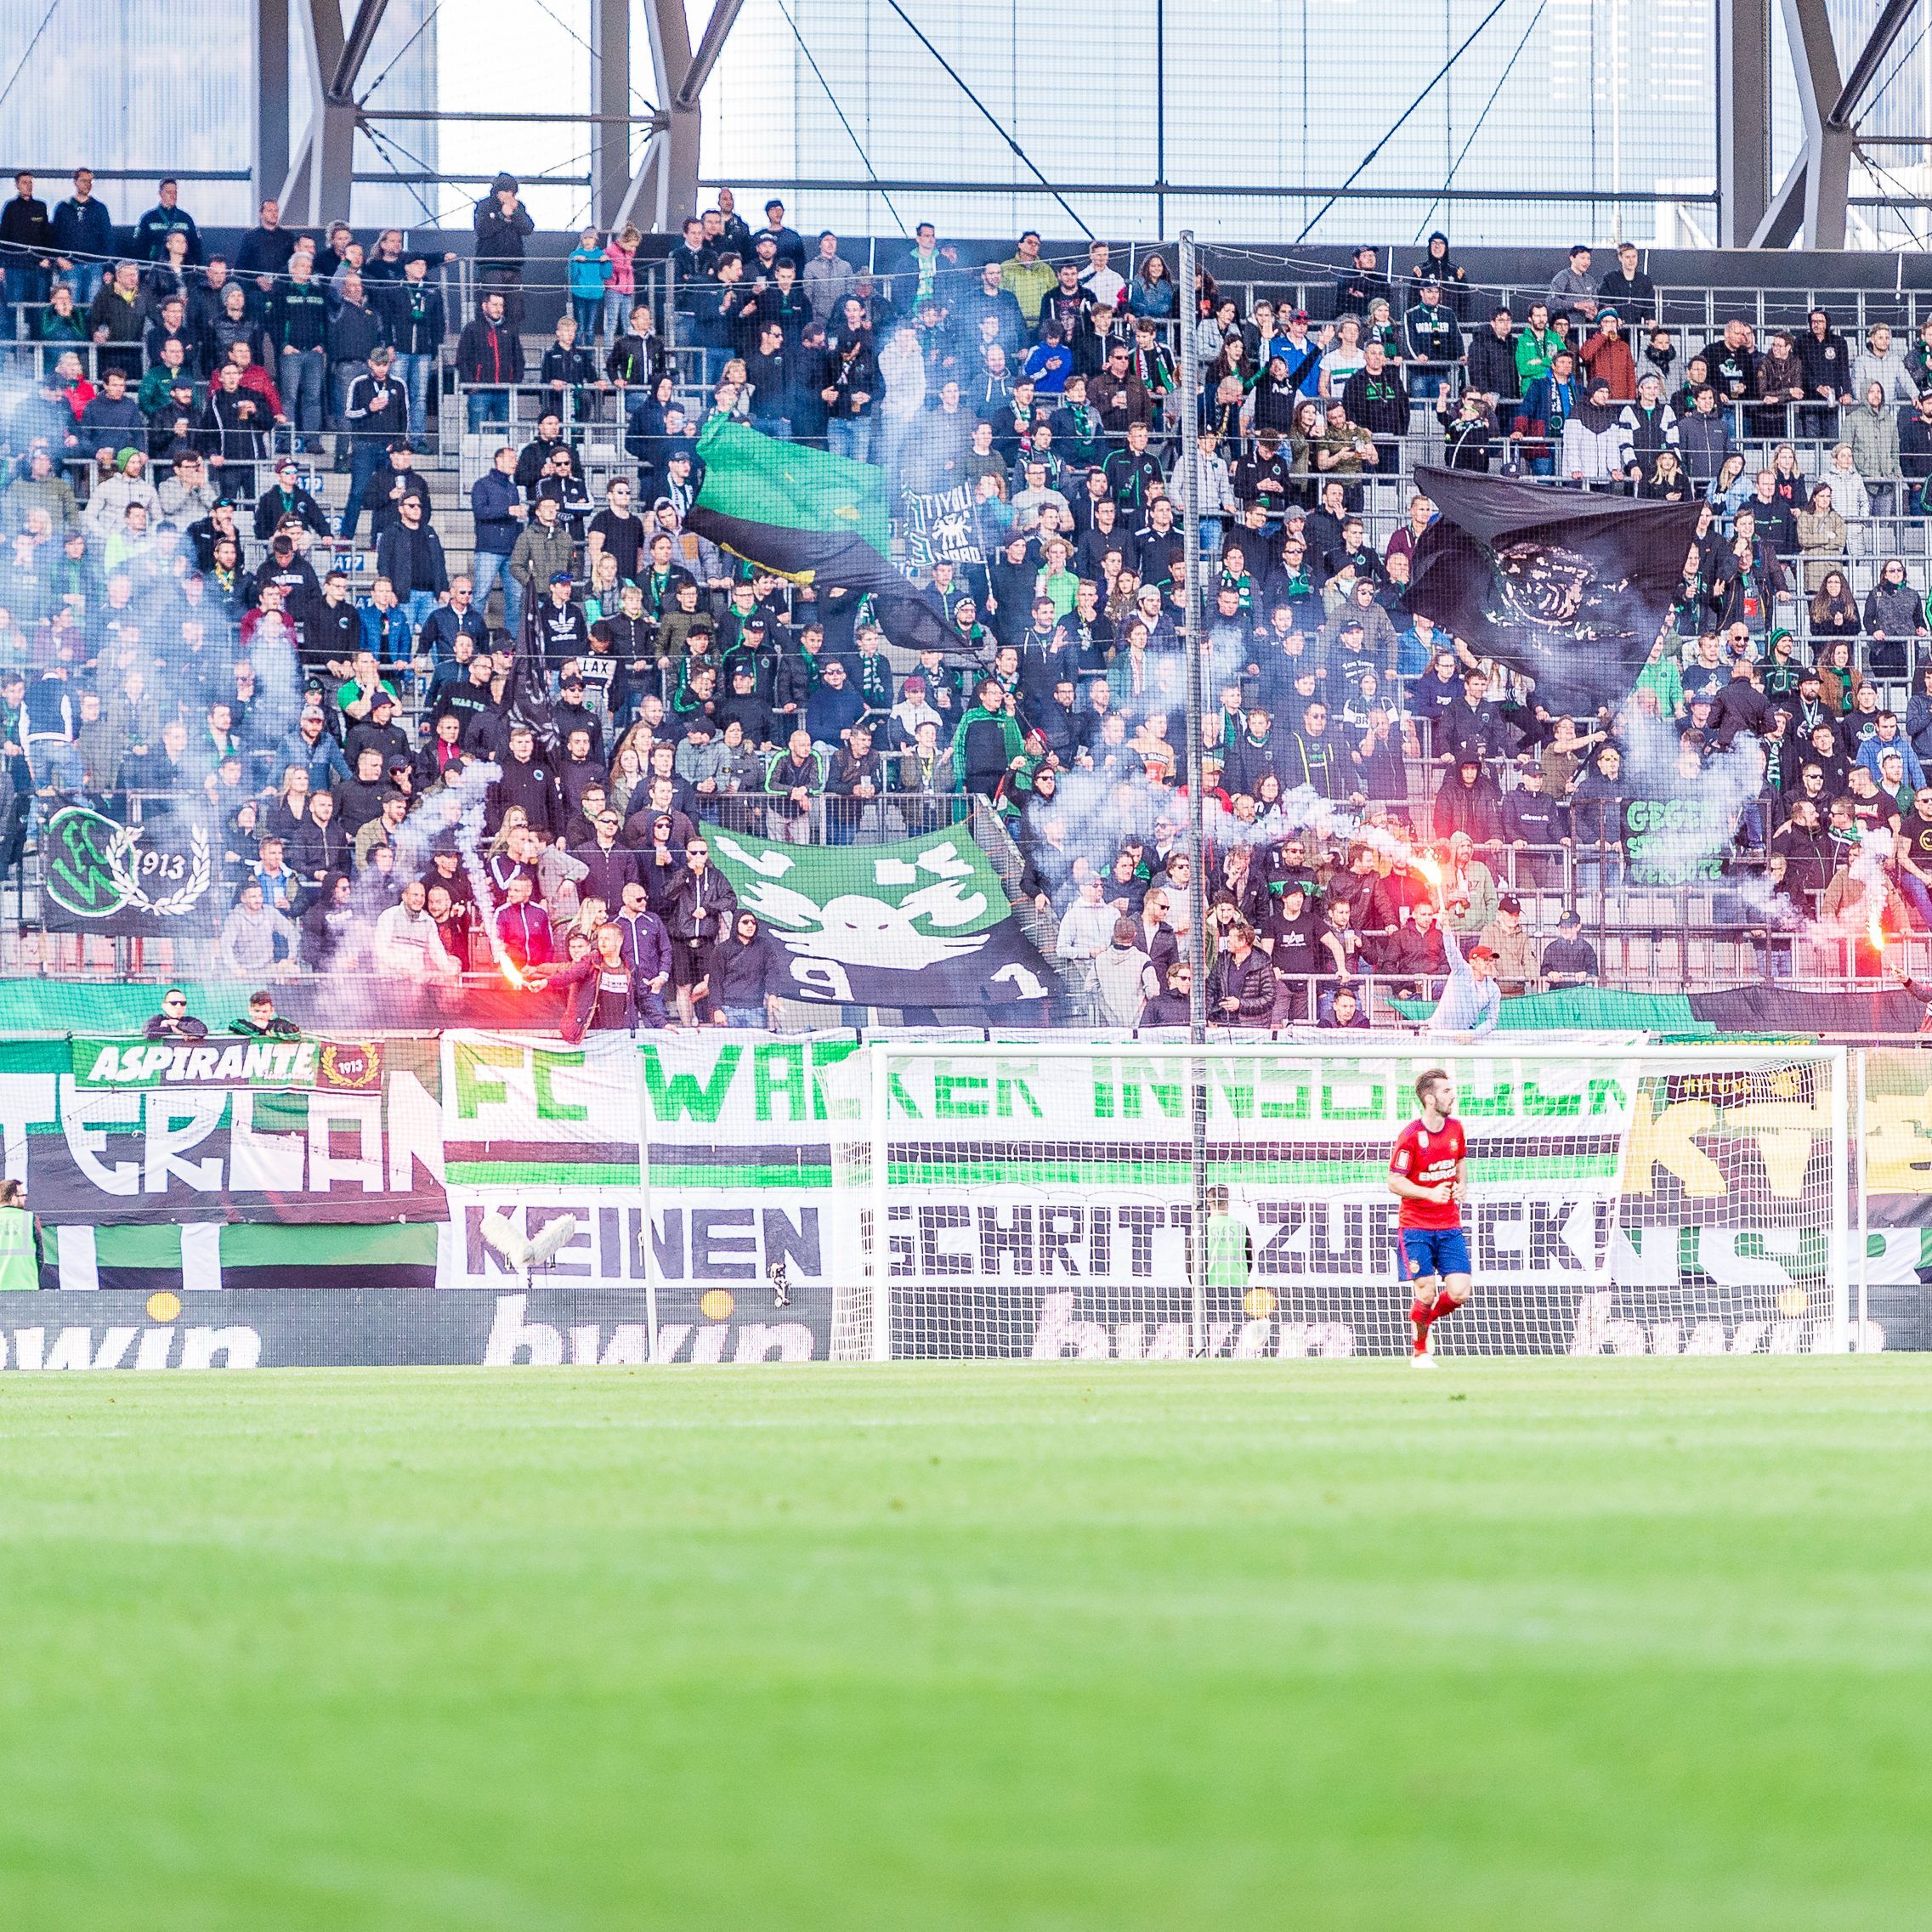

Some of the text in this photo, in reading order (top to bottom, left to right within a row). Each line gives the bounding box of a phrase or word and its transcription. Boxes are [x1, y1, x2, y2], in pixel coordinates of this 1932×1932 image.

[1416, 321, 1449, 334] WACER
[921, 481, 972, 519] TIVOLI
[582, 660, 609, 674] LAX
[135, 847, 186, 881] 1913
[87, 1042, 316, 1083] ASPIRANTE
[337, 1058, 364, 1075] 1913
[455, 1044, 588, 1121] FC
[1418, 1166, 1457, 1183] ENERG
[1428, 1158, 1456, 1172] WIEN
[465, 1200, 1616, 1280] KEINEN SCHRITT ZURCK!
[0, 1291, 262, 1371] win
[484, 1289, 816, 1366] bwin
[1030, 1286, 1357, 1360] bwin
